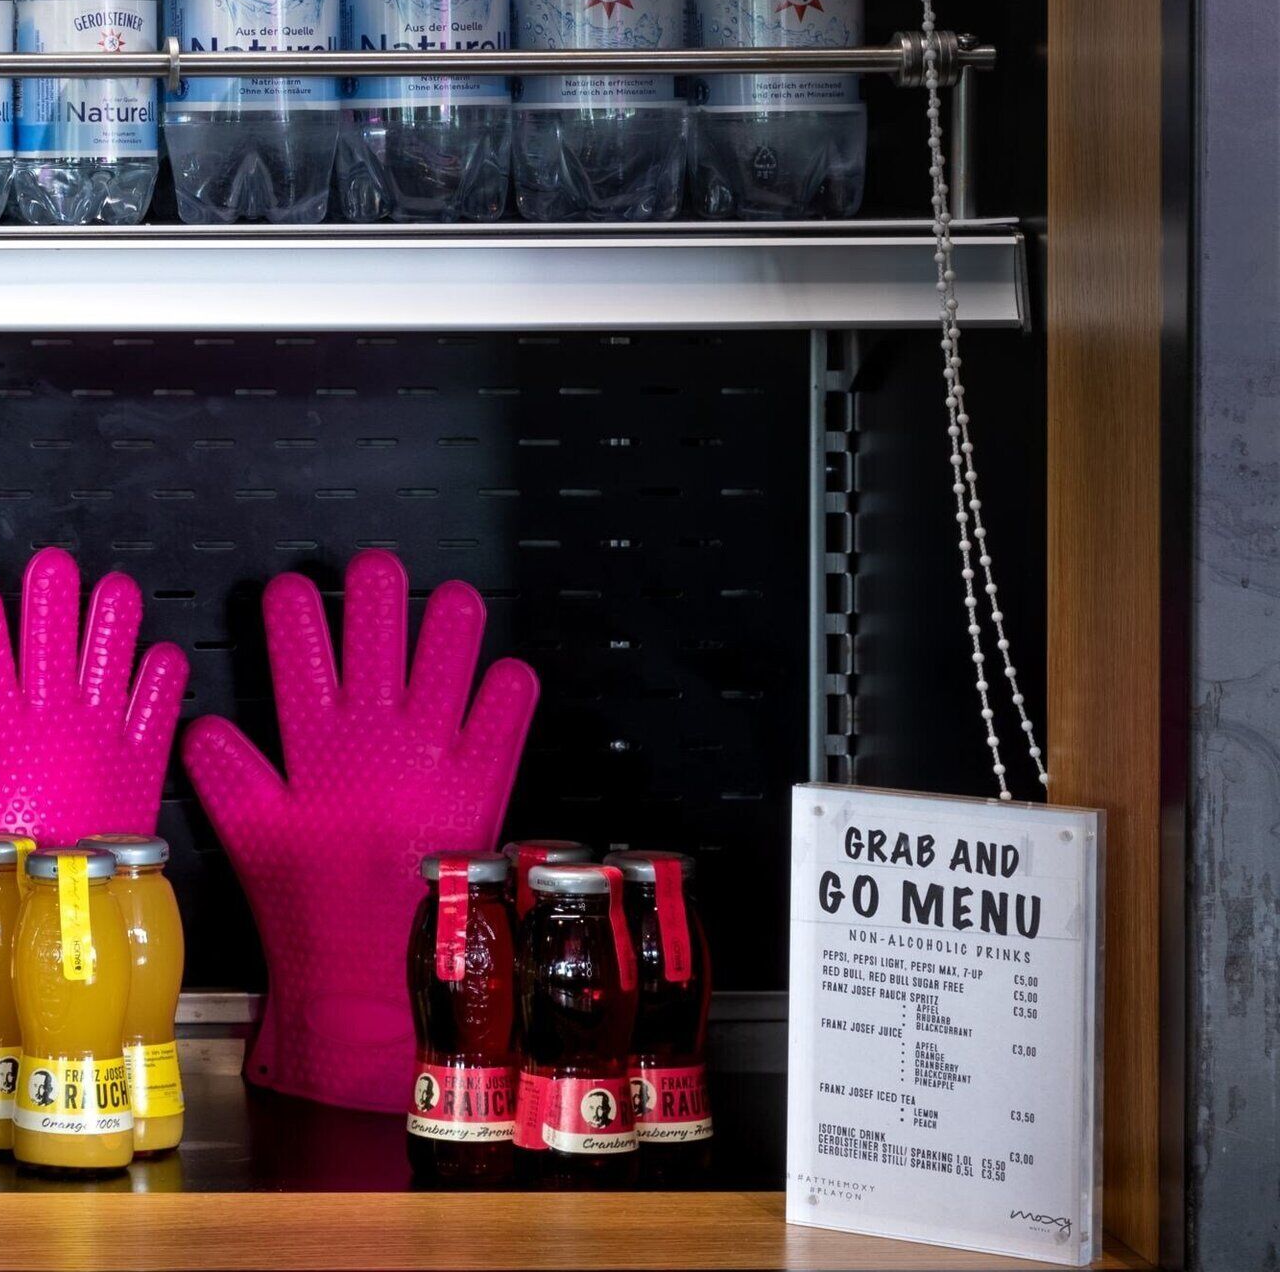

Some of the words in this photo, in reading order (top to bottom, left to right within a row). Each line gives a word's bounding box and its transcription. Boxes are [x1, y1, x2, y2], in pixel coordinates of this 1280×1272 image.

[74, 11, 143, 33] GEROLSTEINER
[235, 27, 256, 37] Aus
[260, 26, 278, 37] der
[282, 25, 314, 38] Quelle
[66, 101, 155, 123] Naturell
[845, 826, 935, 868] GRAB
[949, 839, 1019, 878] AND
[819, 871, 879, 918] GO
[902, 880, 1041, 939] MENU
[849, 929, 967, 955] NON-ALCOHOLIC
[976, 945, 1030, 963] DRINKS
[823, 966, 840, 976] RED
[869, 971, 886, 983] RED
[890, 974, 909, 986] BULL
[913, 977, 939, 990] SUGAR
[943, 981, 964, 993] FREE
[854, 954, 877, 966] PEPSI
[911, 962, 935, 974] PEPSI
[963, 968, 983, 980] 7-UP
[822, 981, 848, 993] FRANZ
[852, 985, 876, 997] JOSEF
[880, 988, 906, 1001] RAUCH
[910, 993, 939, 1005] SPRITZ
